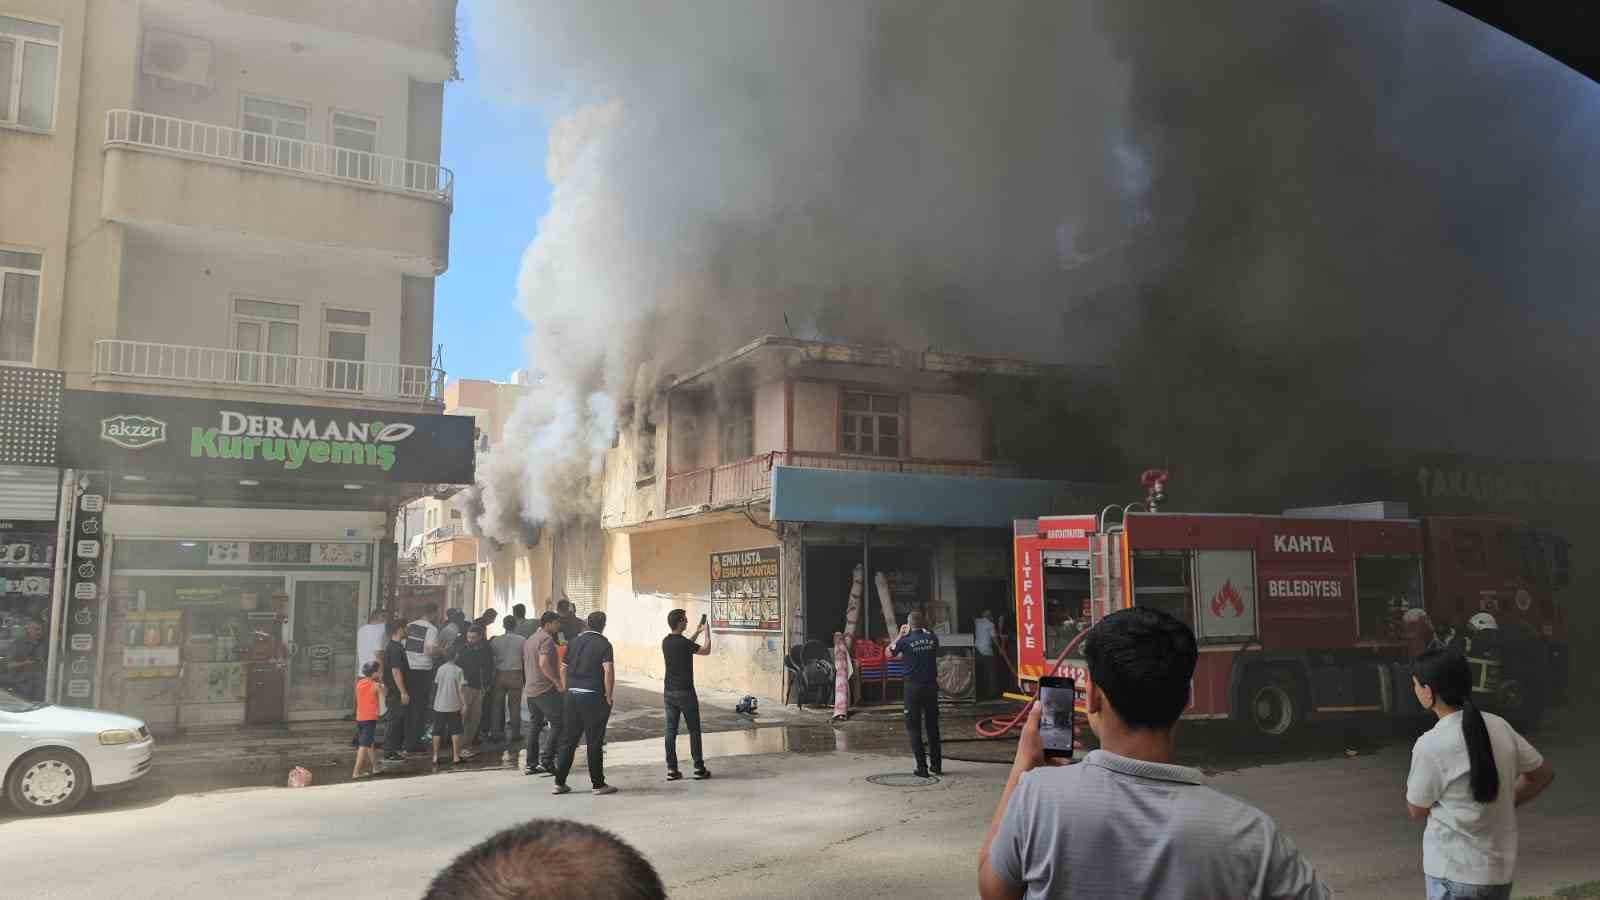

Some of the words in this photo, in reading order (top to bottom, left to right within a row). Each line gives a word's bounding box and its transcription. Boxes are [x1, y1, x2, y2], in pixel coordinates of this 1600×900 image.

[108, 422, 160, 438] akzer
[219, 411, 369, 442] DERMAN
[1274, 534, 1334, 553] KAHTA
